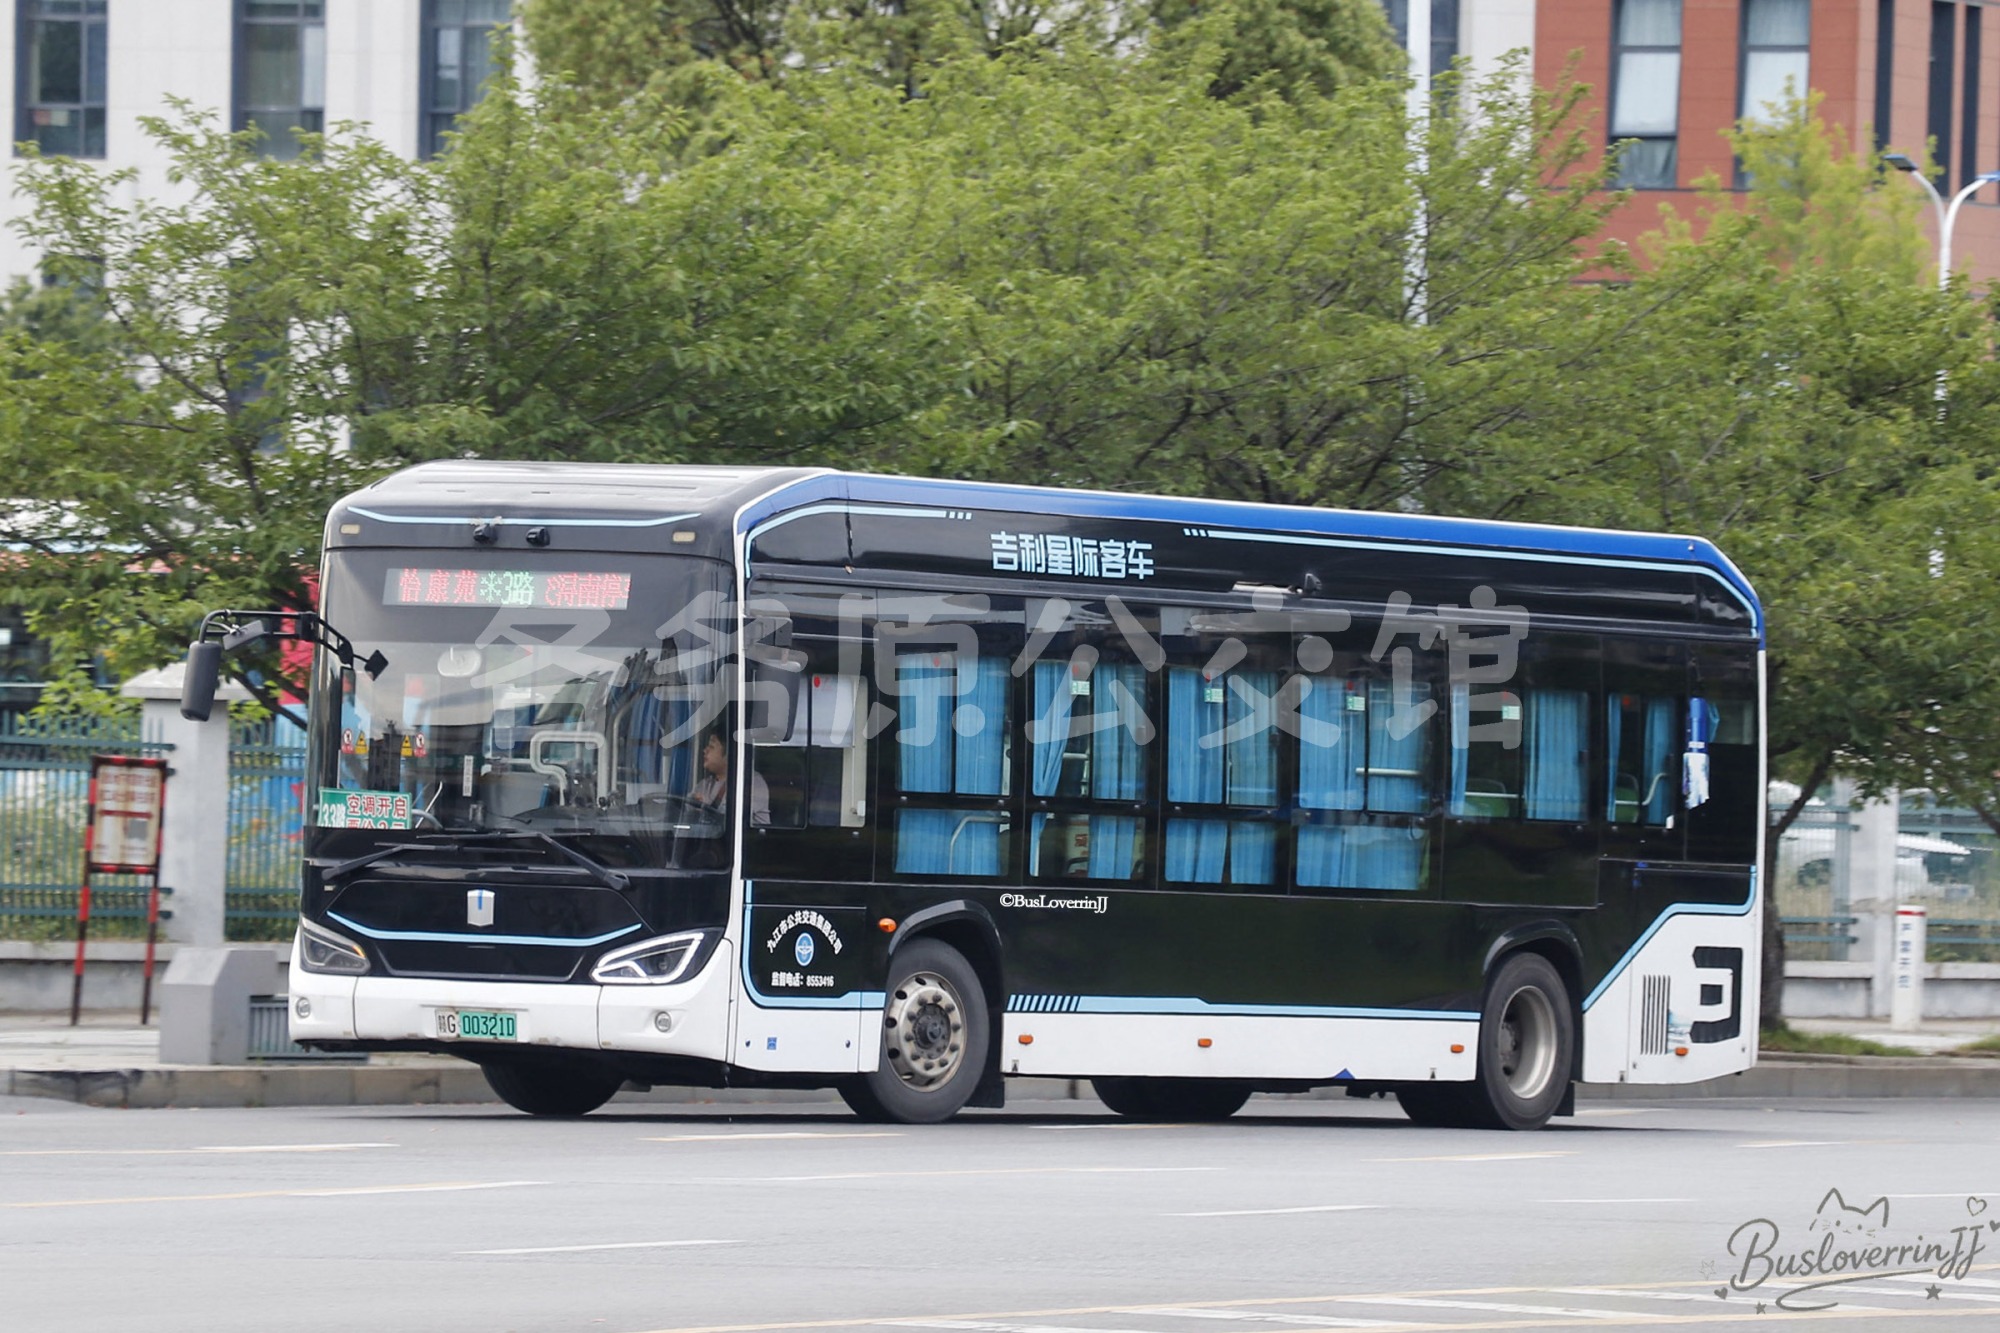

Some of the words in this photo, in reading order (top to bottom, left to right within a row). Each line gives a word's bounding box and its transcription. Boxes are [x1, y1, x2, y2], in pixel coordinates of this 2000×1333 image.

[990, 530, 1155, 580] 吉利星际客车
[347, 793, 408, 820] 空调开启
